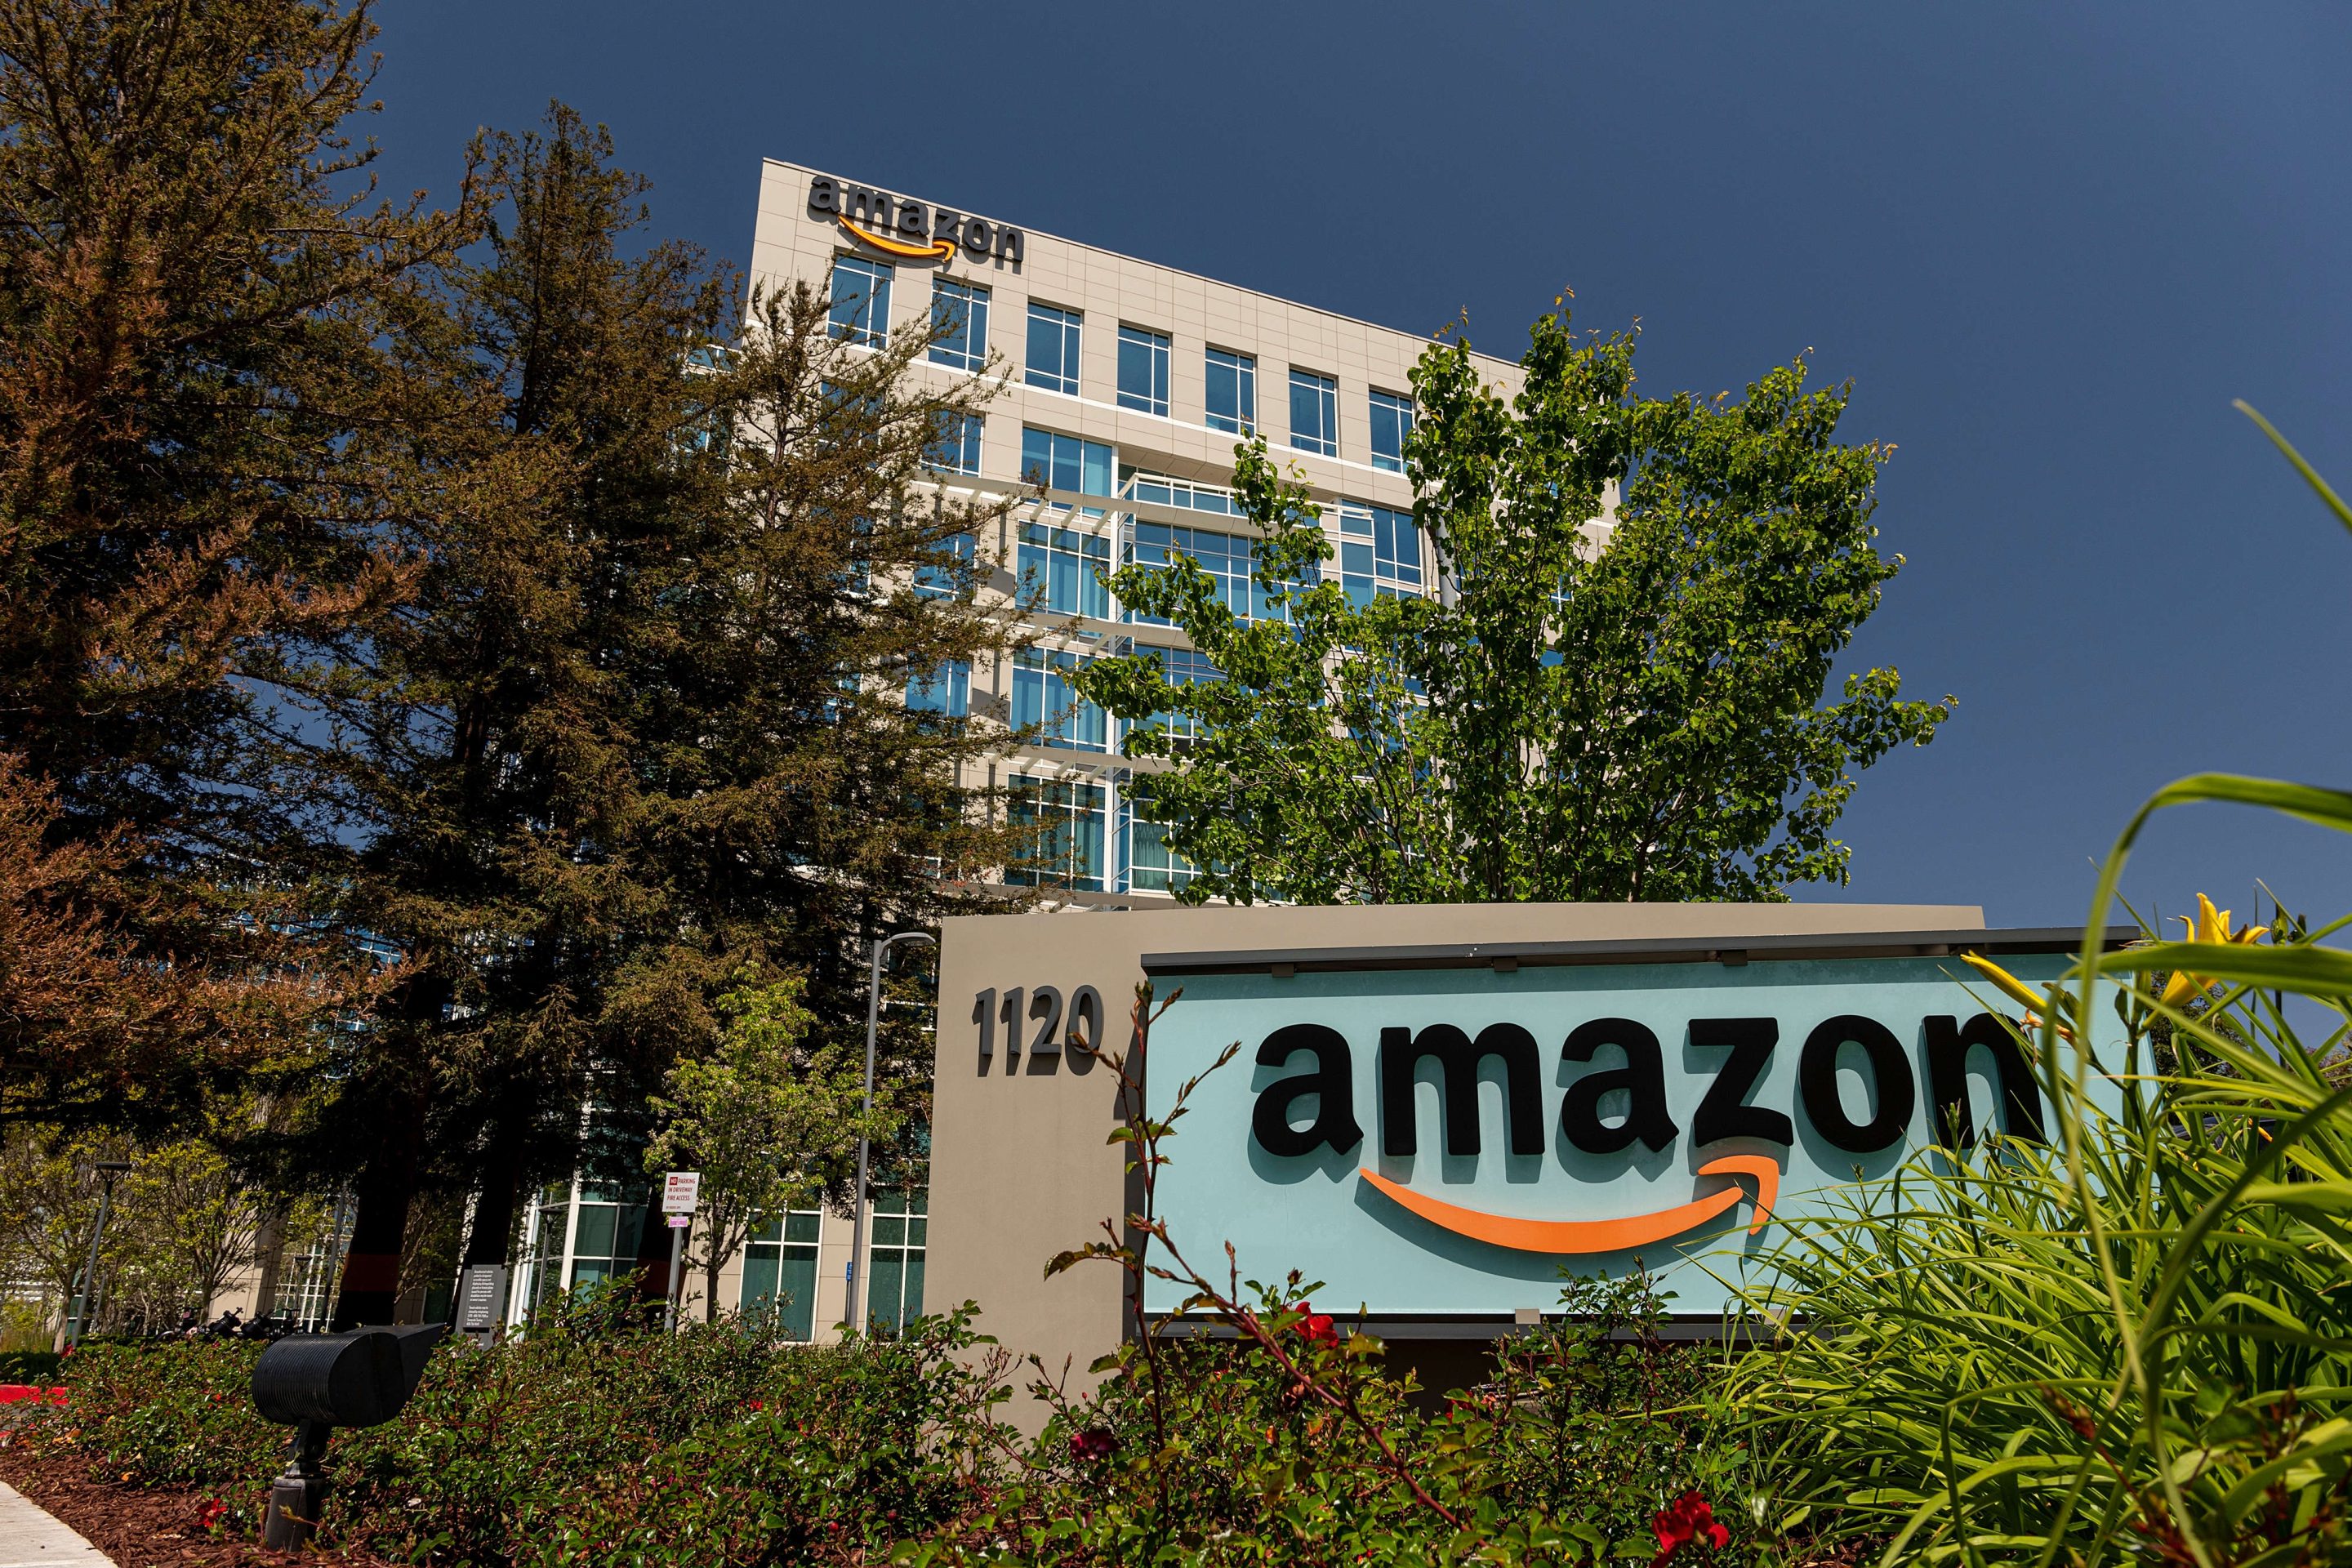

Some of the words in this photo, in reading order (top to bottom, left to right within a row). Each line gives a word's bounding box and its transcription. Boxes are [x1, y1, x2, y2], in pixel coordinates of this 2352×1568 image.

[808, 175, 1024, 262] amazon
[974, 984, 1105, 1056] 1120
[1252, 1012, 2046, 1156] amazon
